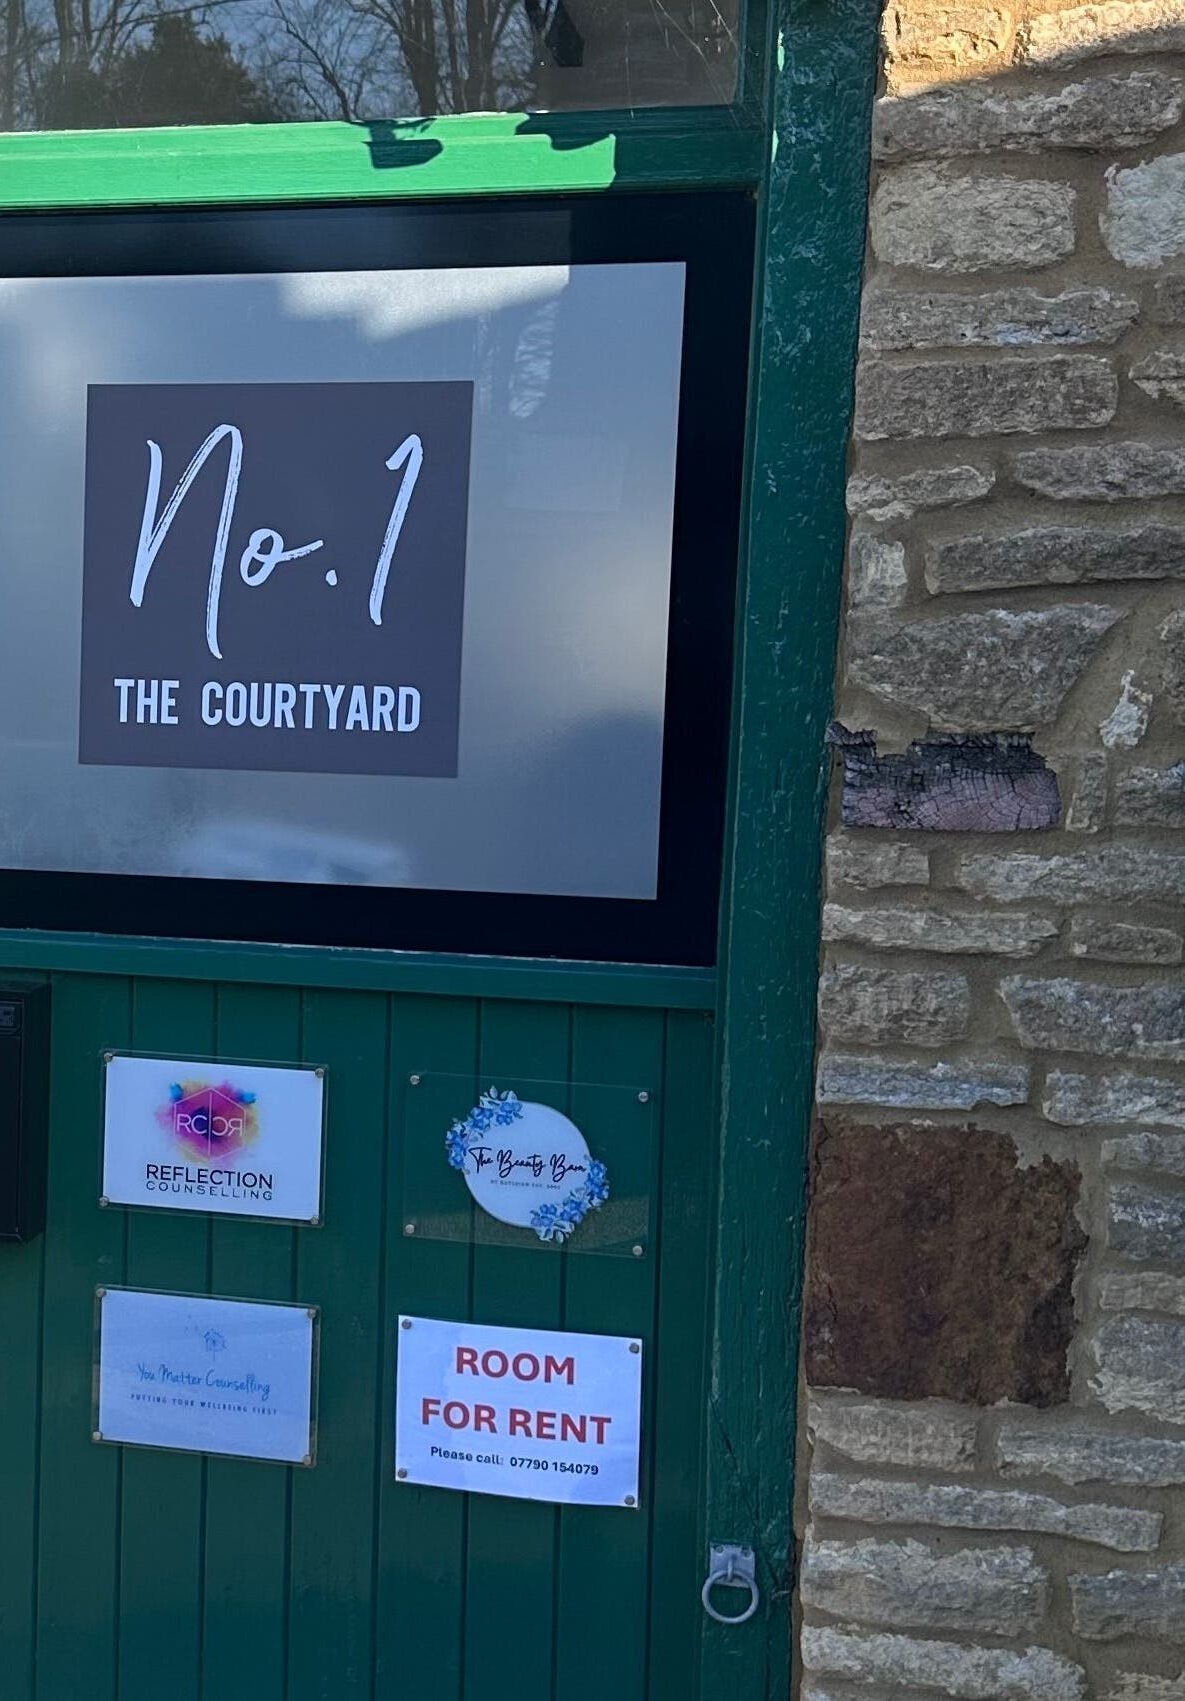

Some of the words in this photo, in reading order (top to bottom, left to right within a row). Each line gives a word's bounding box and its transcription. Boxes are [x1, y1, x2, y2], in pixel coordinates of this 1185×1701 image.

[114, 678, 180, 725] THE
[201, 681, 421, 733] COURTYARD
[146, 1164, 273, 1190] REFLECTION
[468, 1147, 493, 1173] The
[497, 1149, 546, 1178] Beauty
[146, 1181, 273, 1201] COUNSELLING
[456, 1346, 575, 1386] ROOM
[138, 1363, 155, 1382] You
[159, 1364, 202, 1385] Matter
[205, 1369, 270, 1401] Counselling
[131, 1393, 166, 1404] PUTTING
[172, 1397, 194, 1406] YOUR
[252, 1406, 277, 1416] FIRST
[422, 1397, 497, 1434] FOR
[509, 1408, 612, 1445] RENT
[430, 1446, 473, 1462] Please
[476, 1453, 503, 1466] call:
[510, 1456, 549, 1471] 07790
[552, 1461, 599, 1476] 154079
